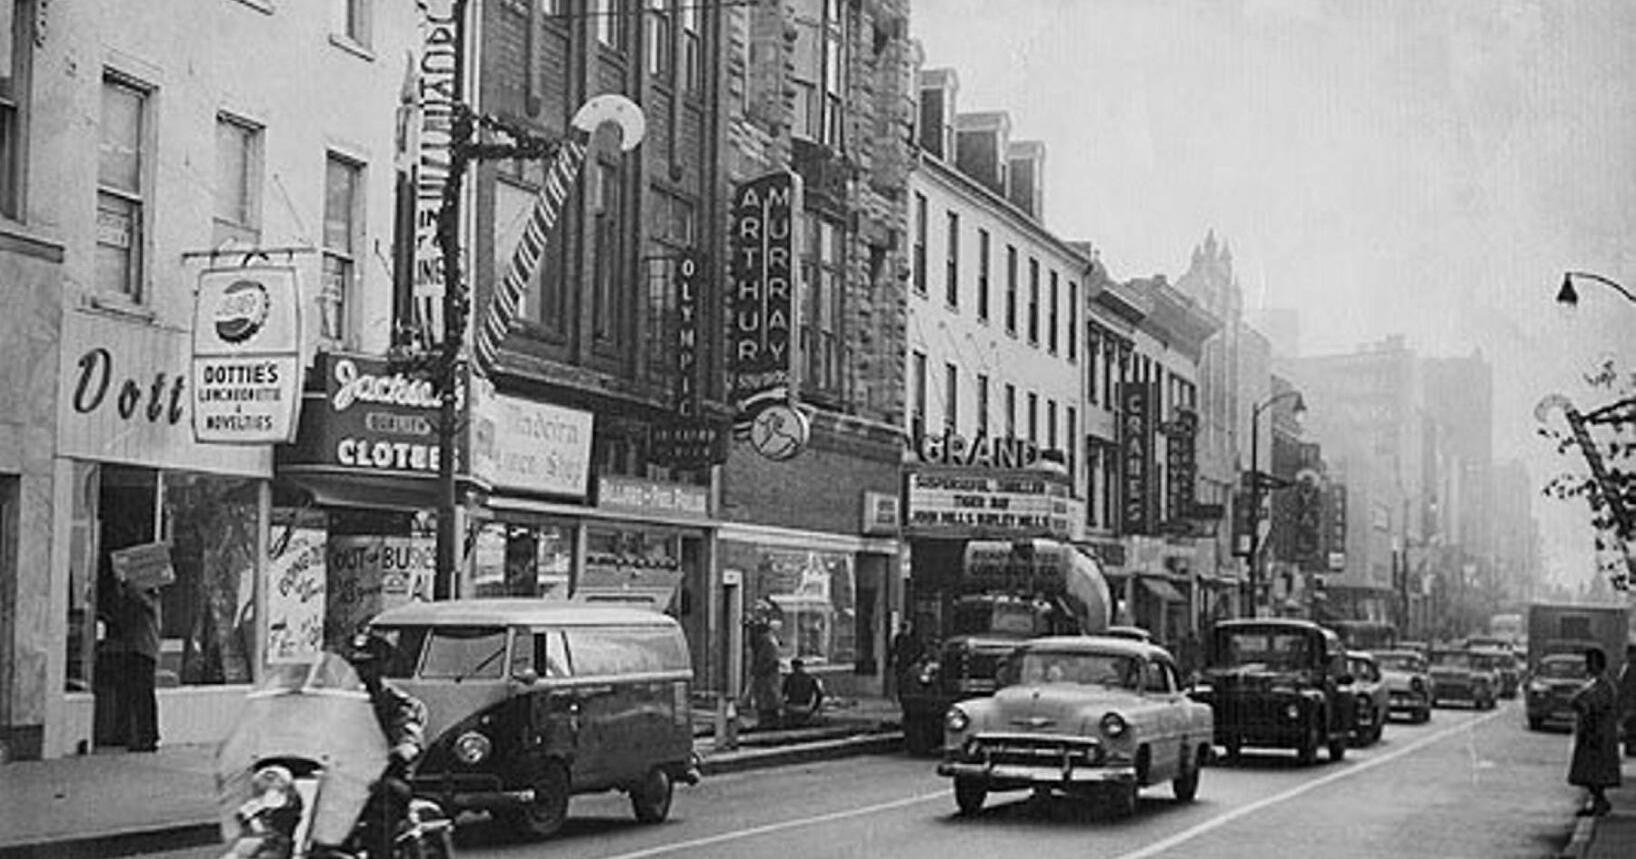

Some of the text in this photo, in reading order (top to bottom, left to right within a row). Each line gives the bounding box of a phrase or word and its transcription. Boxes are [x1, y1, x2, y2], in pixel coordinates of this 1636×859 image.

[738, 187, 761, 361] ARTHUR
[768, 186, 789, 362] MURRAY
[680, 258, 695, 417] OLYMPIC
[204, 362, 279, 384] DOTTIE'S
[206, 414, 273, 431] NOVELTIES
[919, 434, 1039, 468] GRAND
[954, 494, 1010, 510] TIGER BAY
[914, 510, 938, 524] JOHN
[940, 511, 975, 525] MILLS
[1018, 513, 1050, 528] MILLS
